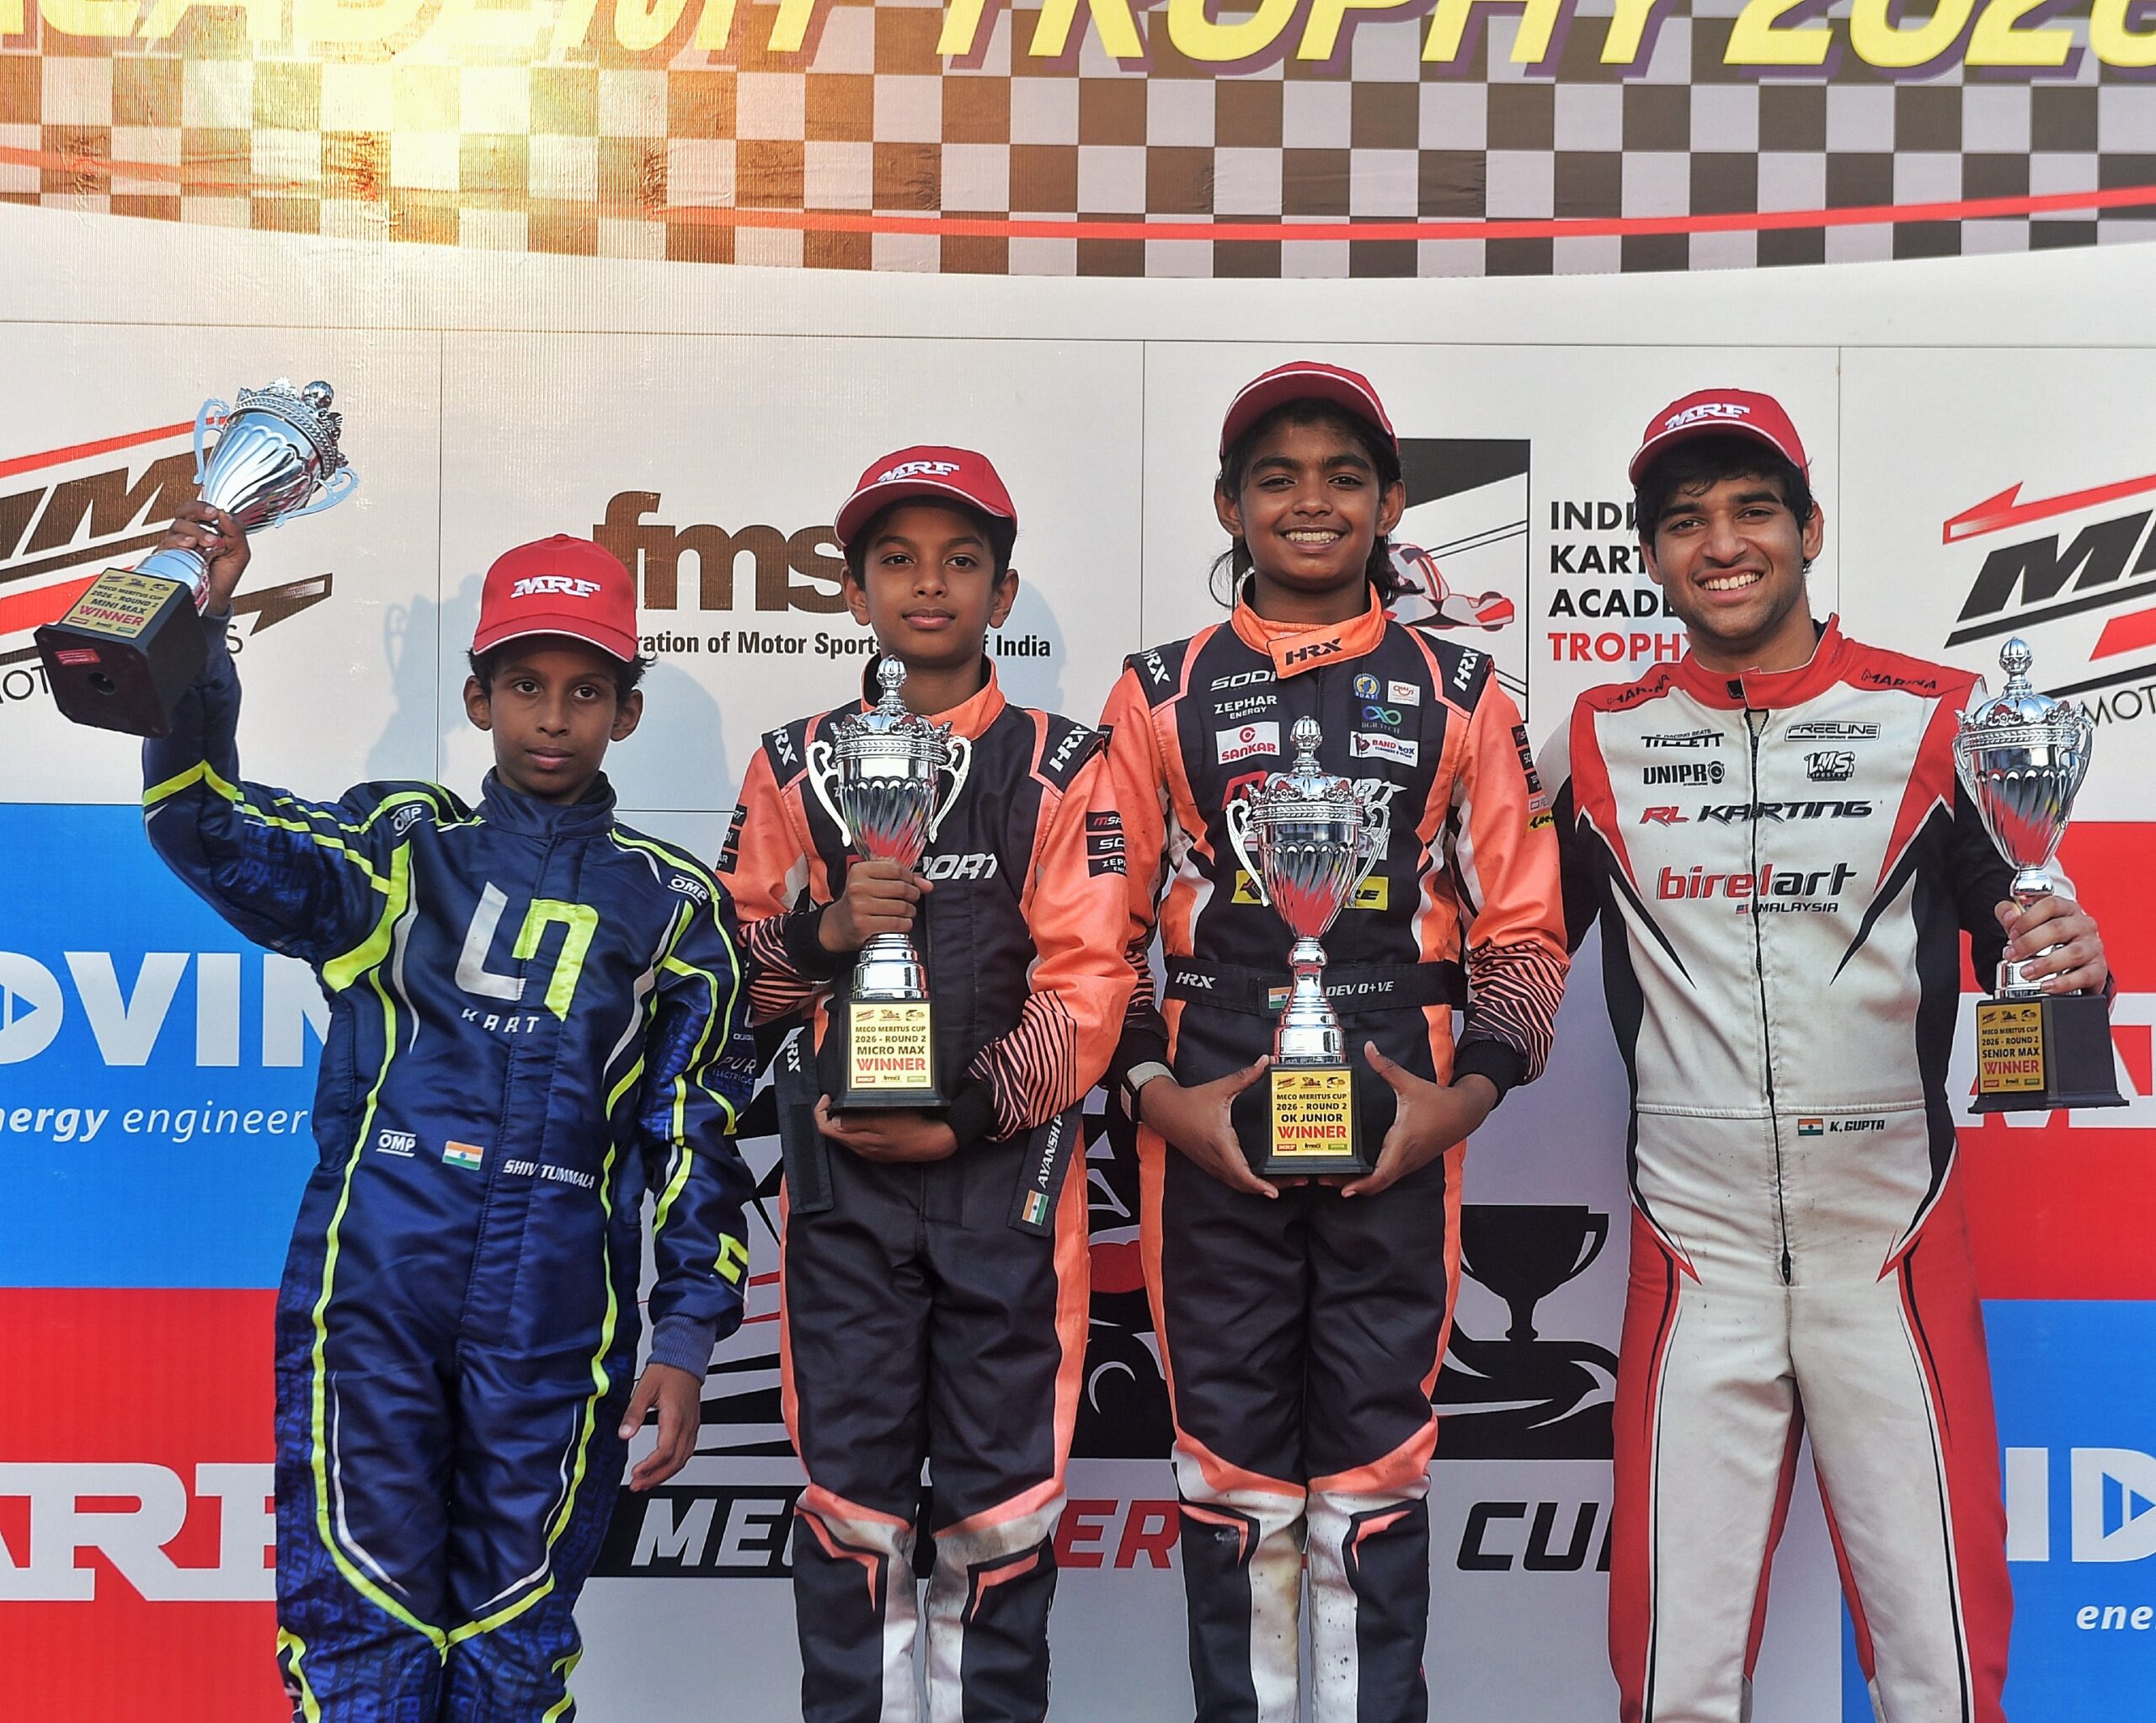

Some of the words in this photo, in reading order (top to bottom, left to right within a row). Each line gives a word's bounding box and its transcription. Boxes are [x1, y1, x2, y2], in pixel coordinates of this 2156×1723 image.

[1664, 403, 1751, 429] MRF
[877, 461, 960, 483] MRF
[1550, 502, 1637, 531] INDI
[90, 589, 112, 600] 2026
[119, 595, 151, 606] ROUND
[510, 575, 601, 599] MRF
[79, 605, 145, 627] WINNER
[90, 598, 120, 609] MINI
[120, 605, 148, 615] MAX
[707, 632, 730, 653] of
[738, 632, 807, 653] Motor
[995, 634, 1050, 657] India
[1284, 637, 1343, 666] HRX
[1548, 632, 1689, 662] TROPH
[1214, 696, 1278, 715] ZEPHAR
[1230, 707, 1267, 720] ENERGY
[1789, 723, 1878, 734] FREELINE
[1049, 726, 1091, 772] HRX
[1372, 739, 1396, 749] BAND
[1398, 745, 1415, 755] BOX
[1639, 806, 1689, 827] RL
[1697, 800, 1872, 825] KARTING
[1102, 858, 1125, 868] ZEP
[670, 878, 707, 900] OMP
[1758, 903, 1838, 914] MALAYSIA
[1175, 971, 1216, 990] HRX
[1326, 984, 1358, 997] DEV
[462, 1008, 540, 1034] KART
[857, 1046, 894, 1055] MICRO
[898, 1046, 925, 1054] MAX
[2005, 1037, 2032, 1045] ROUND
[1982, 1048, 2015, 1059] SENIOR
[2018, 1047, 2040, 1056] MAX
[856, 1058, 926, 1071] WINNER
[1983, 1059, 2039, 1075] WINNER
[0, 1107, 109, 1143] ergy
[122, 1100, 313, 1144] engineer
[1281, 1114, 1297, 1123] OK
[1300, 1113, 1342, 1123] JUNIOR
[1277, 1125, 1347, 1139] WINNER
[378, 1133, 416, 1153] OMP
[1037, 1125, 1061, 1189] AYANSH
[503, 1160, 538, 1176] SHIV
[630, 1499, 795, 1566] ME
[2076, 1605, 2156, 1630] ene
